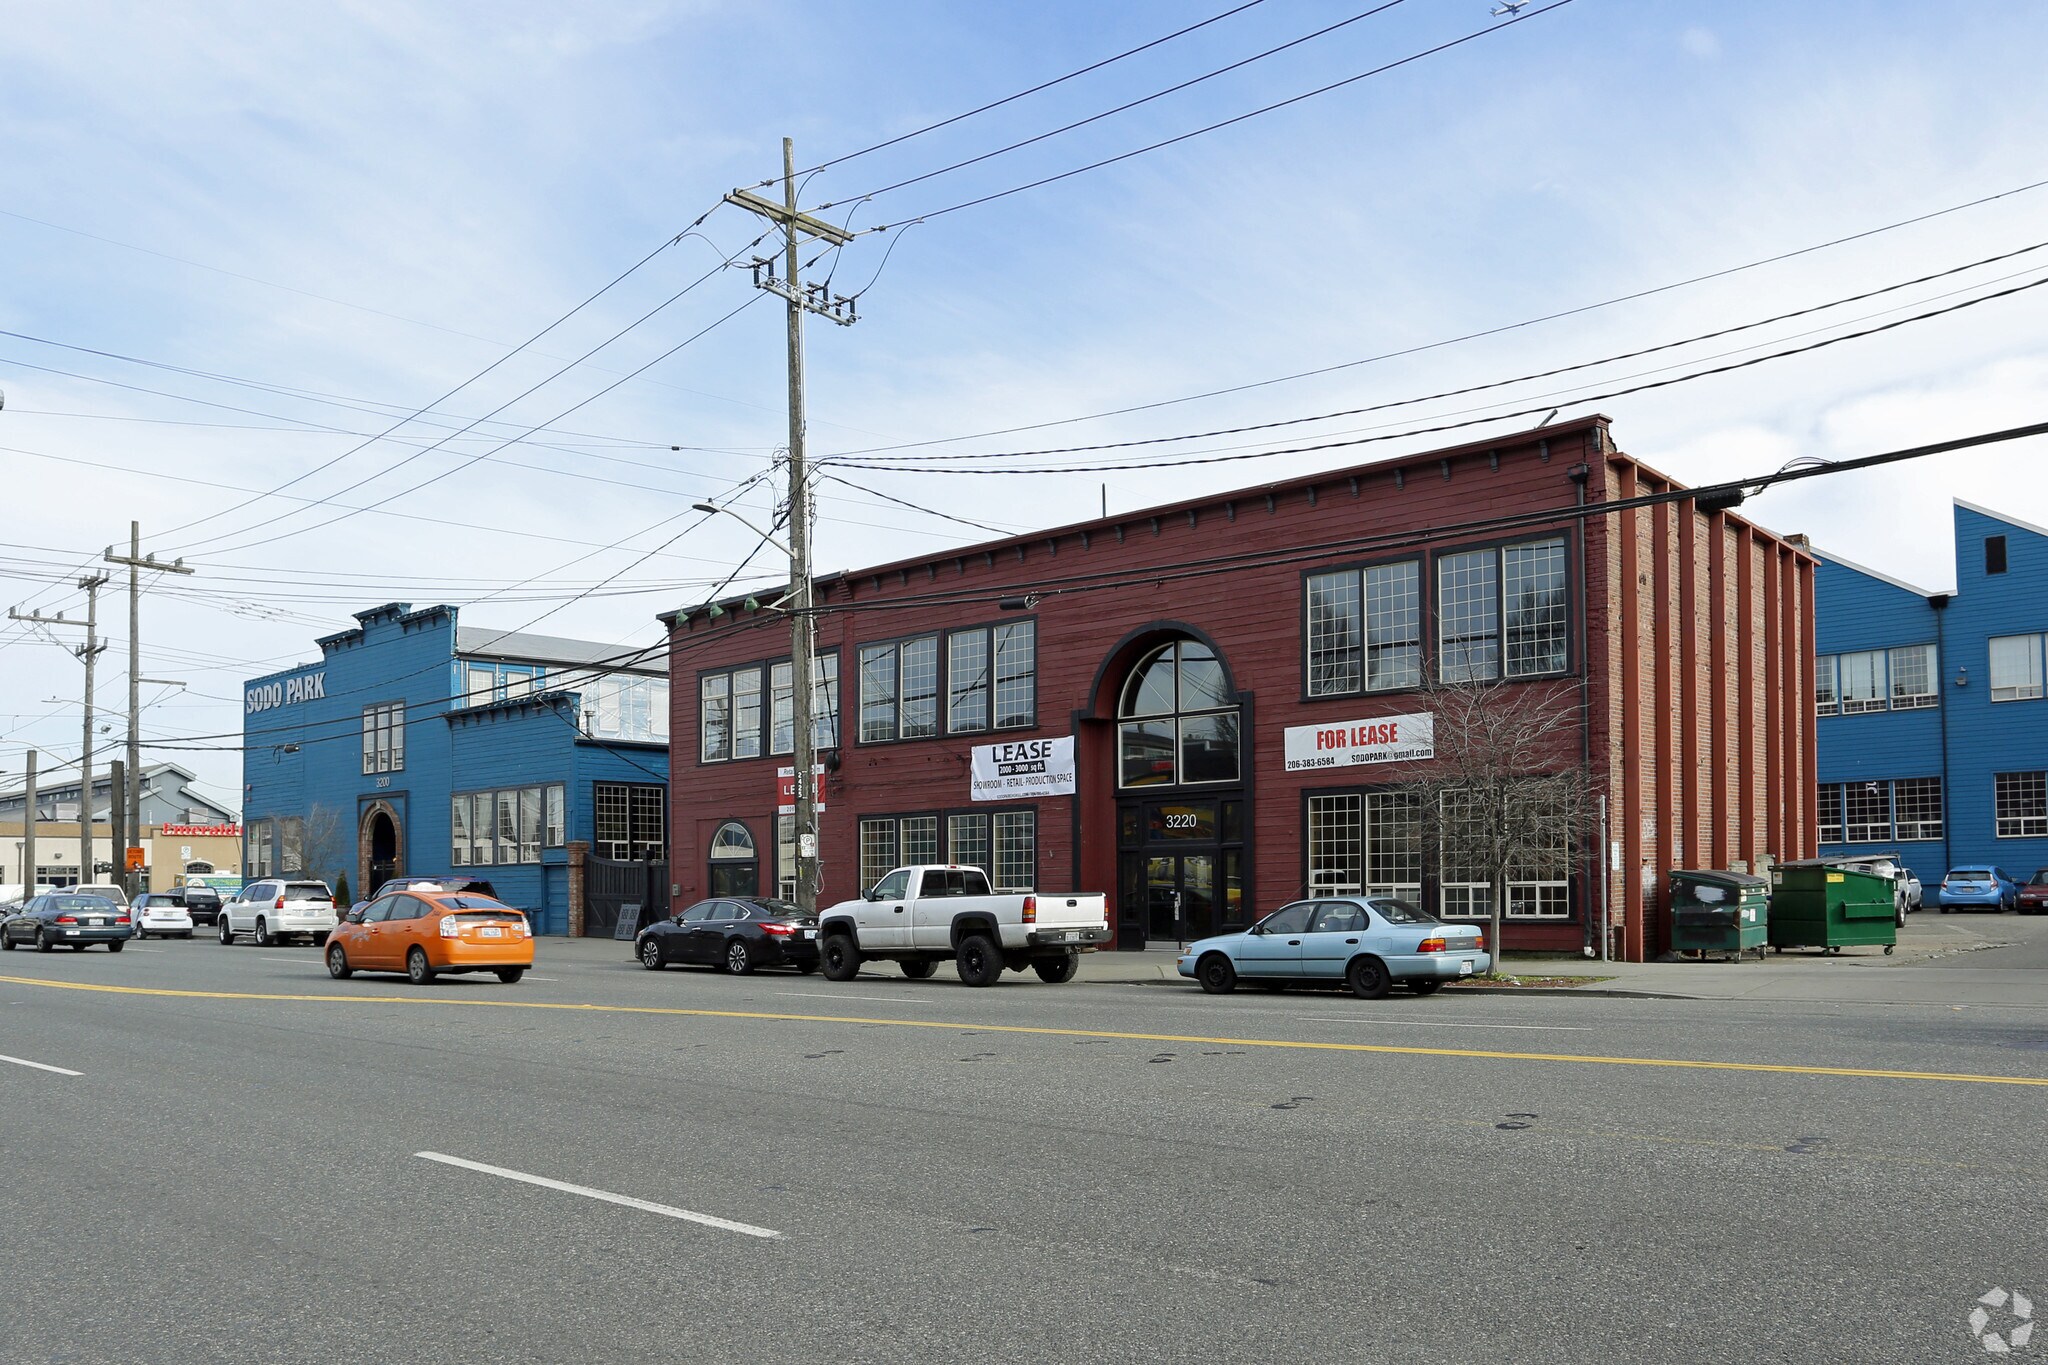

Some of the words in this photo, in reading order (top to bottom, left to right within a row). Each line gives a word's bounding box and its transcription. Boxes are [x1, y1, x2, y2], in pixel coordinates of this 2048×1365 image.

[246, 682, 282, 714] SODO
[286, 672, 326, 704] PARK
[1317, 729, 1346, 750] FOR
[1351, 723, 1398, 747] LEASE
[992, 741, 1052, 763] LEASE
[999, 765, 1012, 774] 2000
[1015, 764, 1028, 773] 3000
[1287, 757, 1335, 769] 206-383-6584
[973, 780, 1002, 790] SHOWROOM
[1025, 775, 1056, 786] PRODUCTION
[1057, 773, 1072, 783] SPACE
[1166, 814, 1197, 828] 3220
[162, 822, 236, 836] Emerald
